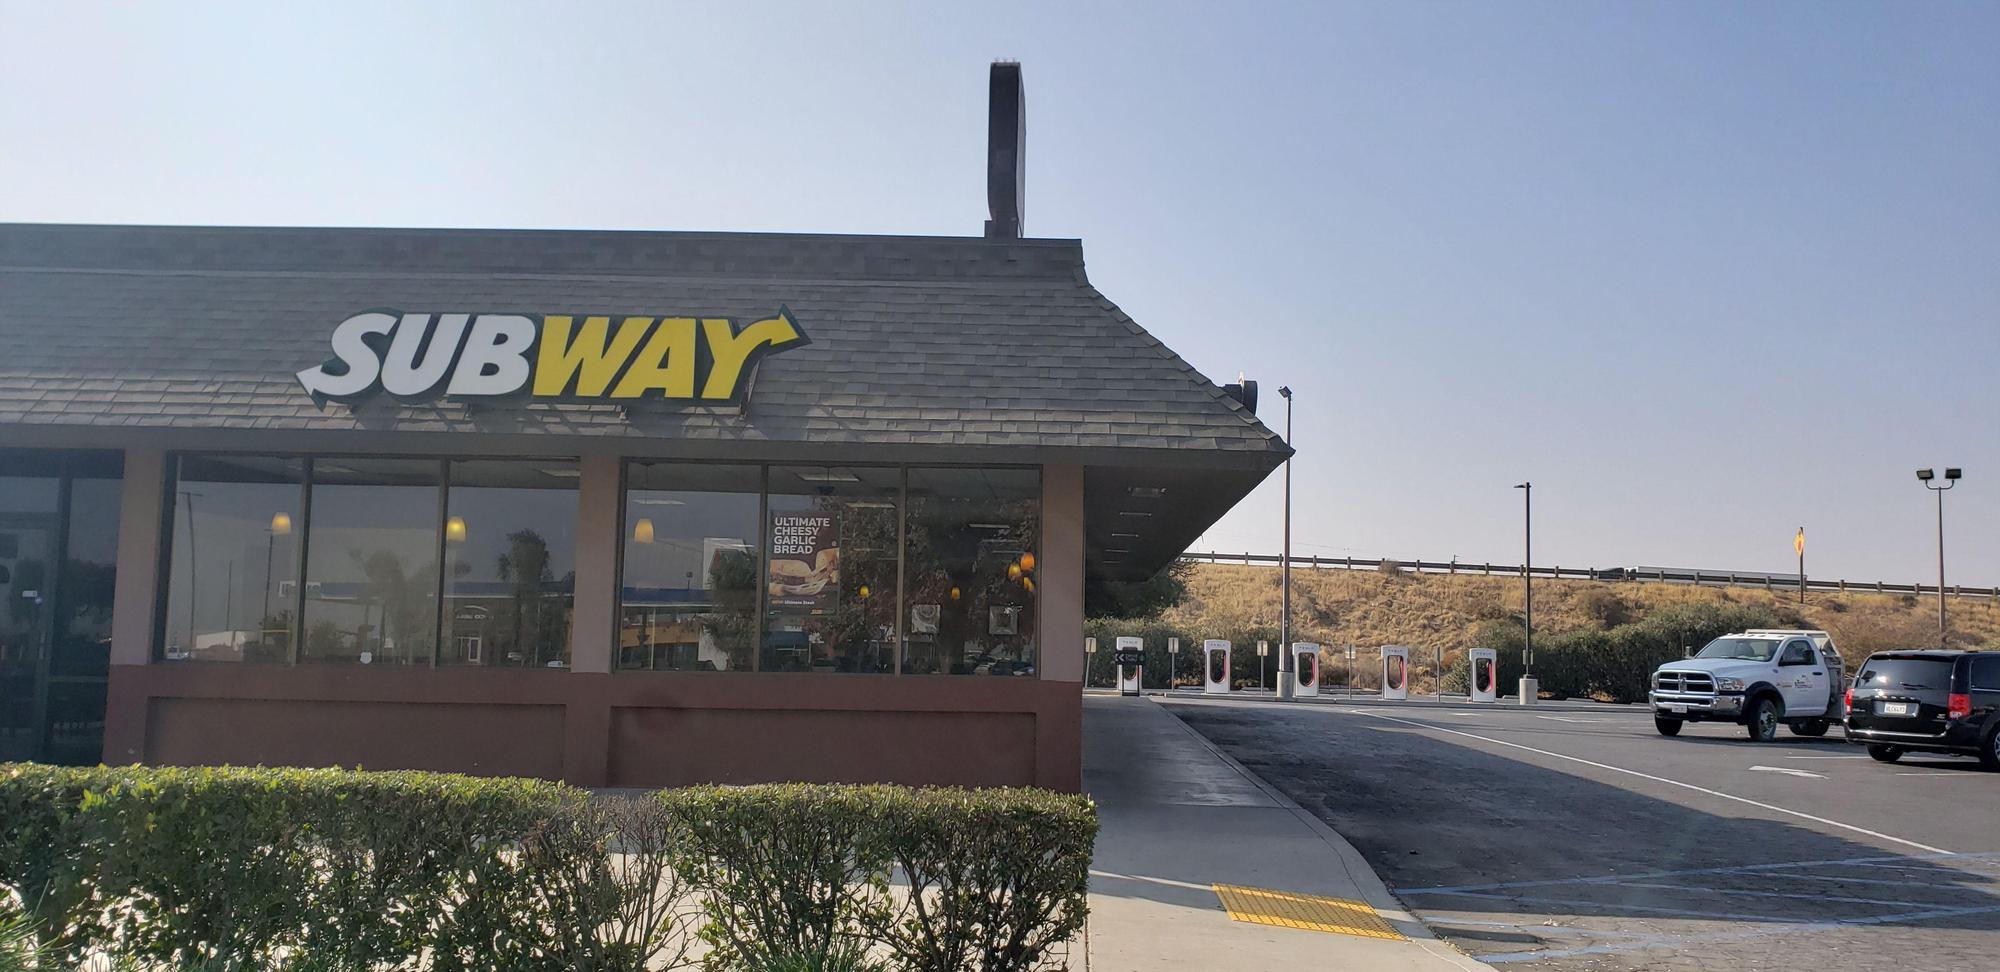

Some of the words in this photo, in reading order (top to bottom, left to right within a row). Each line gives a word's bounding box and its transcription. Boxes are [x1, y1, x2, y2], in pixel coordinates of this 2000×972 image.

[296, 310, 801, 400] SUBWAY
[774, 517, 831, 527] ULTIMATE
[774, 526, 820, 536] CHEESY
[773, 535, 817, 545] GARLIC
[773, 545, 813, 554] BREAD
